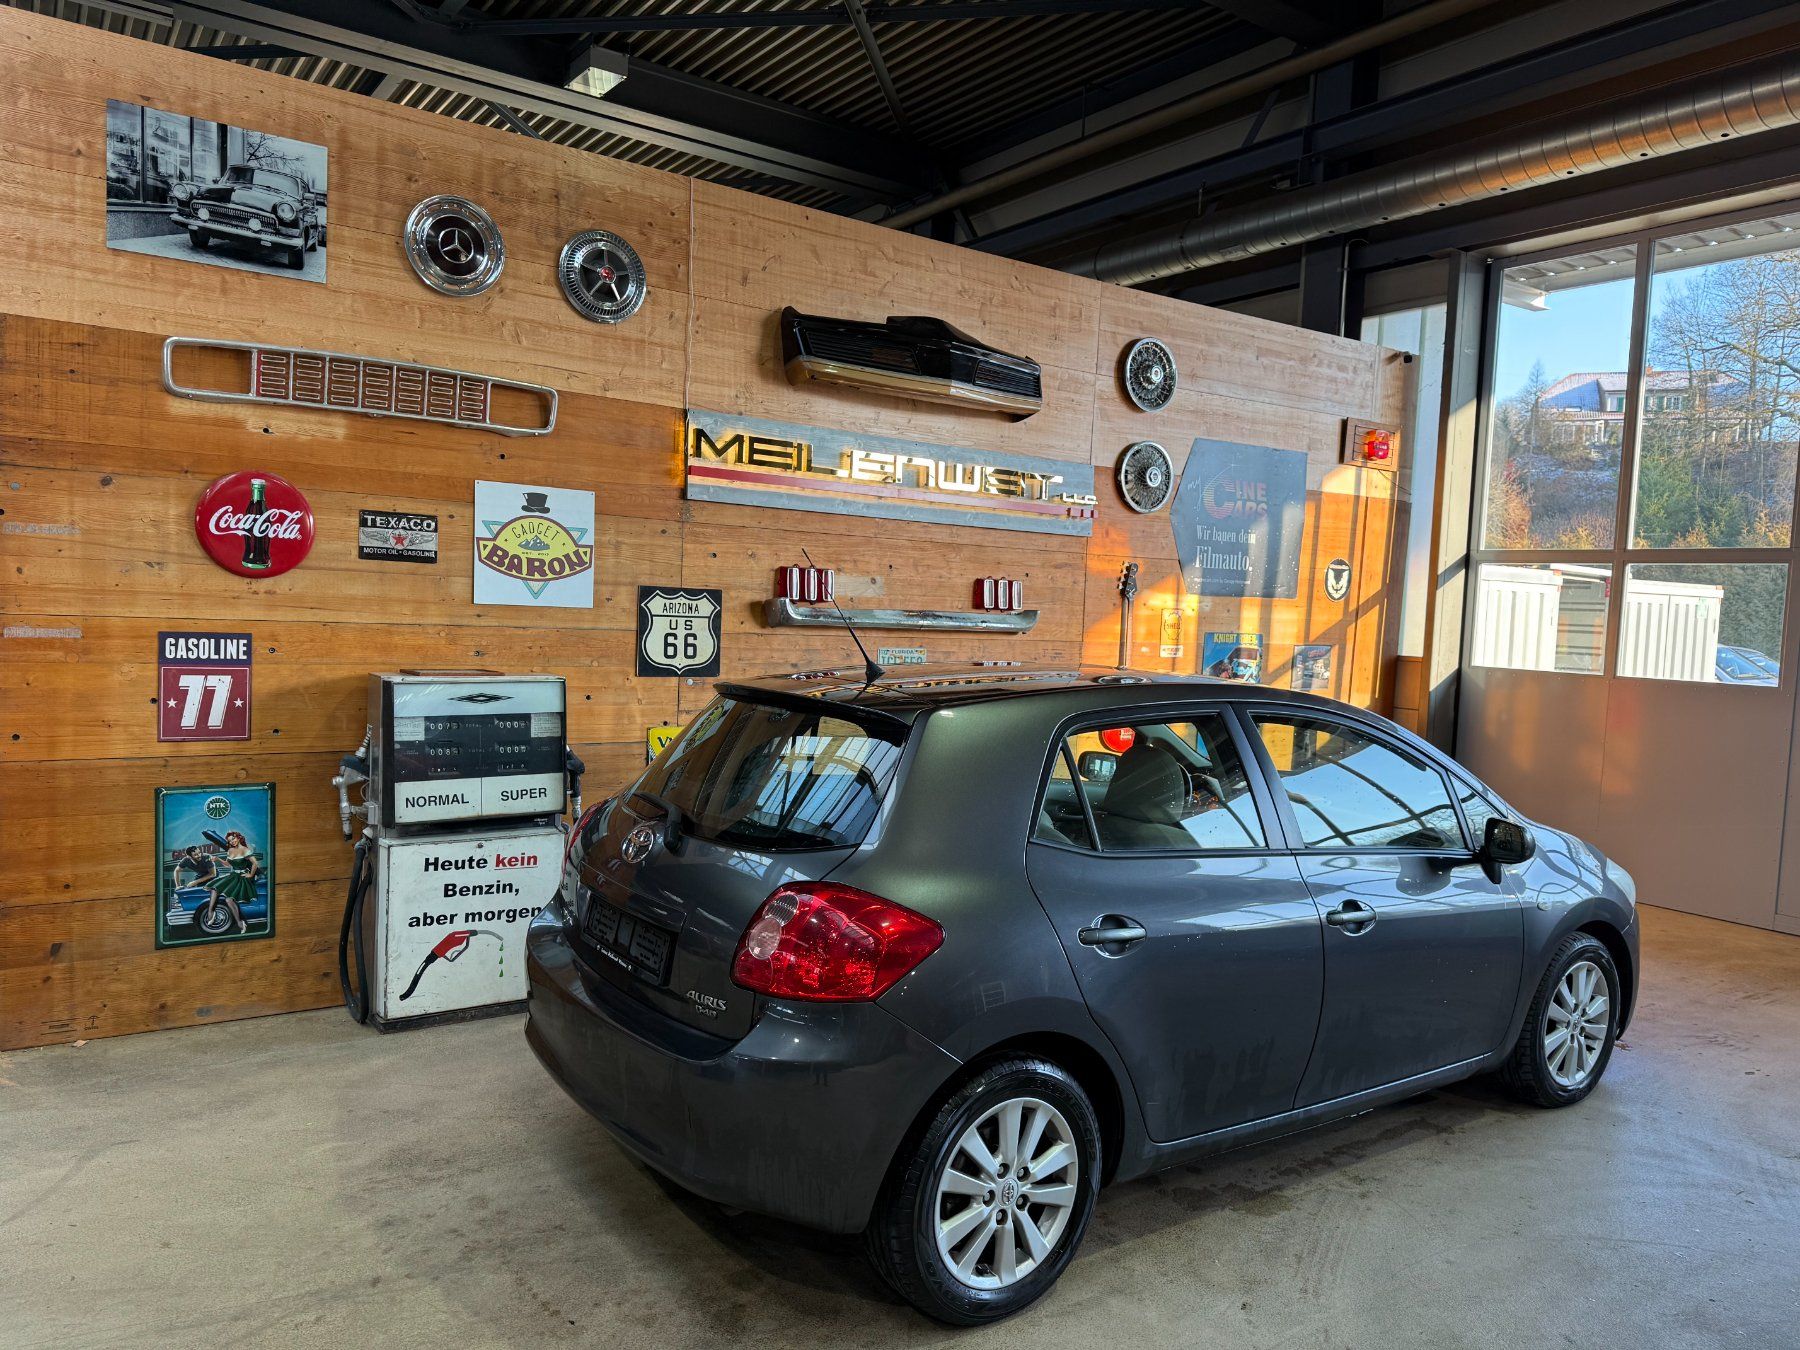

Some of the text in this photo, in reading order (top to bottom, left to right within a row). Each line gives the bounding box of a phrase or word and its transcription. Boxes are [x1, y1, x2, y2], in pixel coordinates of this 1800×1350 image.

[209, 505, 304, 539] Coca-Cola
[363, 515, 436, 532] TEXACO
[511, 521, 560, 541] GADGET
[1196, 524, 1256, 544] Wir bauen dein
[363, 547, 387, 555] MOTOR
[402, 550, 436, 558] GASOLINE
[484, 542, 589, 578] BARON
[1194, 545, 1253, 571] Filmauto.
[662, 602, 700, 615] ARIZONA
[165, 637, 248, 660] GASOLINE
[663, 632, 698, 660] 66
[1213, 633, 1237, 644] KNIGHT
[178, 674, 234, 730] 77
[209, 801, 226, 809] NTK
[405, 787, 547, 809] NORMAL SUPER
[424, 852, 539, 872] Heute kein
[443, 880, 520, 898] Benzin,
[408, 906, 543, 928] aber morgen
[686, 990, 727, 1012] AURIS
